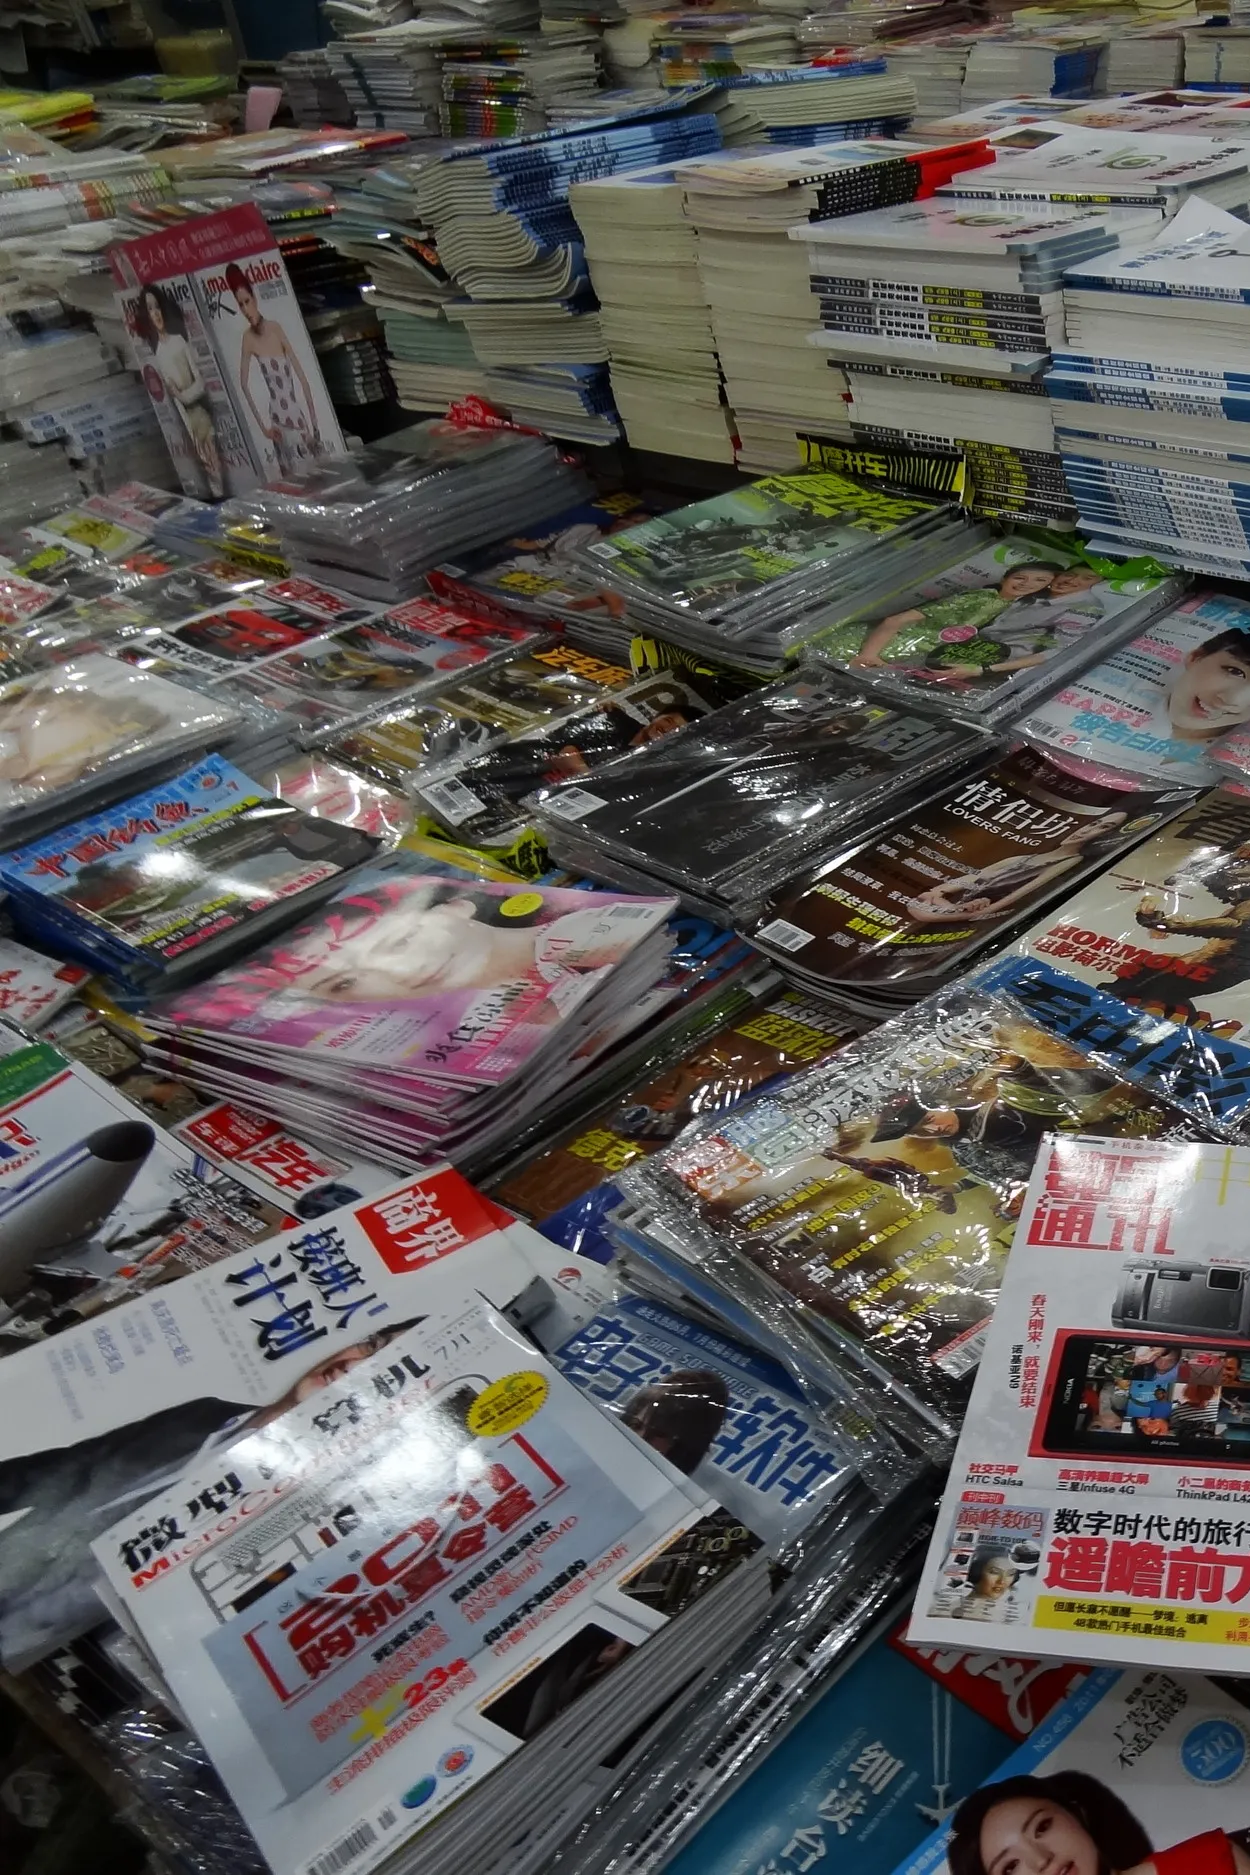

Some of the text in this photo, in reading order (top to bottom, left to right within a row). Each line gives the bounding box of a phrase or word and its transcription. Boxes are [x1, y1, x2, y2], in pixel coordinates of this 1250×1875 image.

[942, 803, 1044, 849] LOVERS FANG
[950, 778, 1077, 842] 情侣坊
[1046, 922, 1220, 984] HORMONE
[372, 1184, 466, 1262] 商界
[1025, 1193, 1176, 1256] 通讯
[225, 1253, 330, 1361] 计划
[1062, 1377, 1075, 1404] NOKIA
[965, 1474, 1025, 1489] HTC Salsa
[1113, 1483, 1136, 1497] 4G
[1175, 1488, 1229, 1504] ThinkPad
[297, 1483, 542, 1677] 购机夏令营
